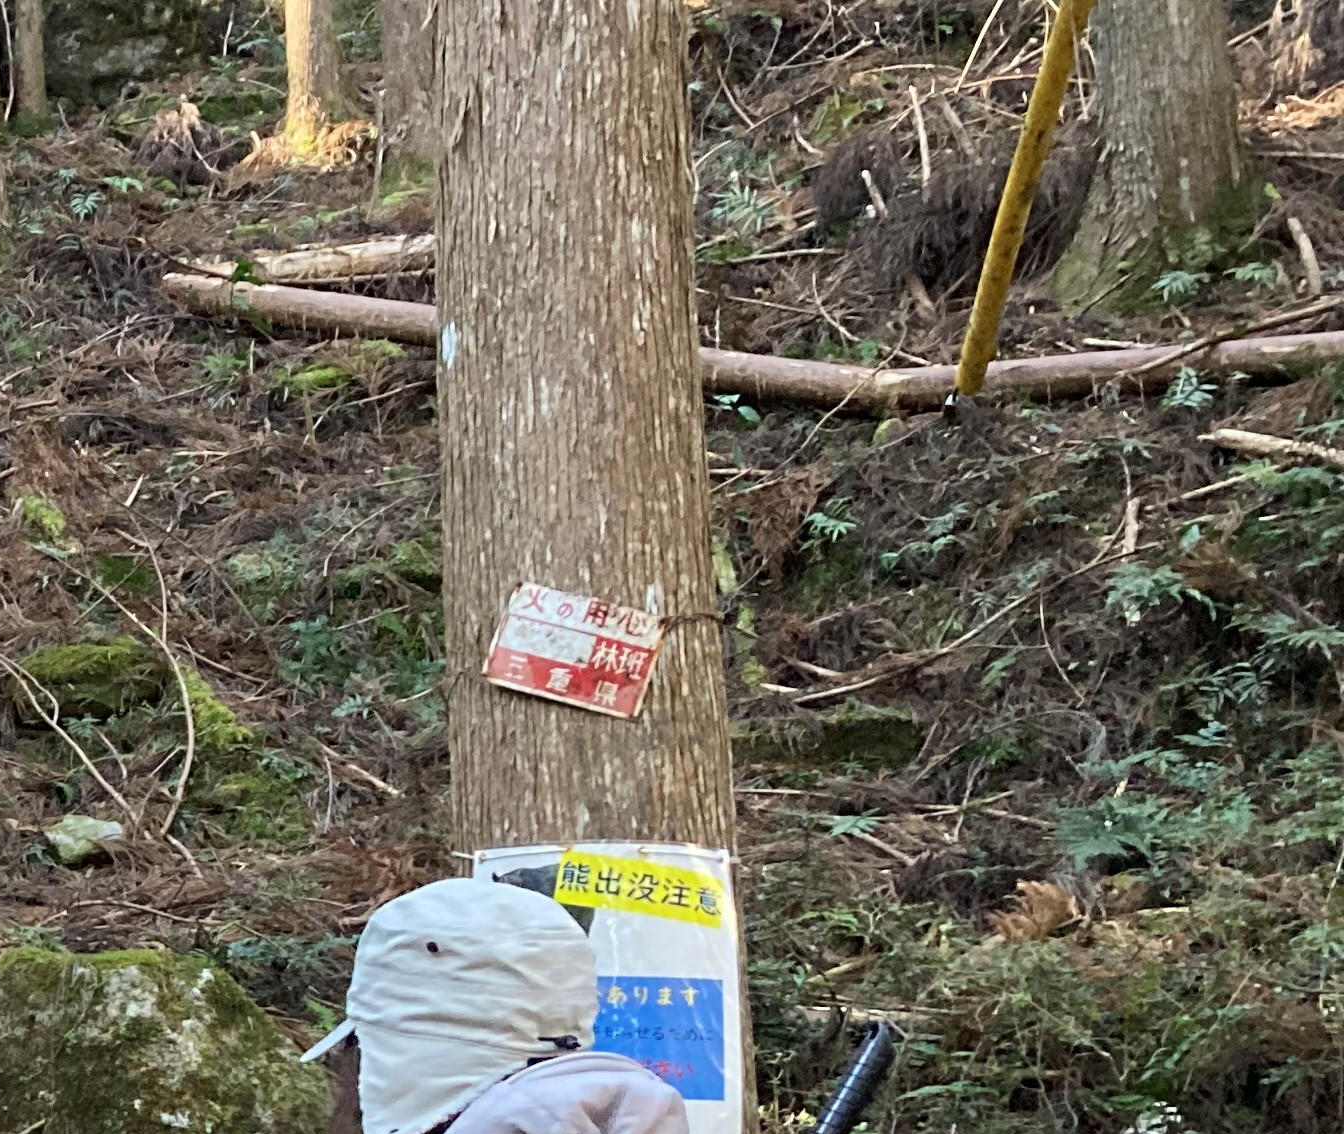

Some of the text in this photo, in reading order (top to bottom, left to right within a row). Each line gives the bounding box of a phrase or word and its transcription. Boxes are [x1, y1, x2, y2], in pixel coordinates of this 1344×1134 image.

[522, 588, 646, 638] 火の用心
[505, 655, 617, 706] 三重県
[590, 640, 649, 680] 林班
[558, 861, 723, 917] 熊出没注意
[596, 985, 701, 1007] あります
